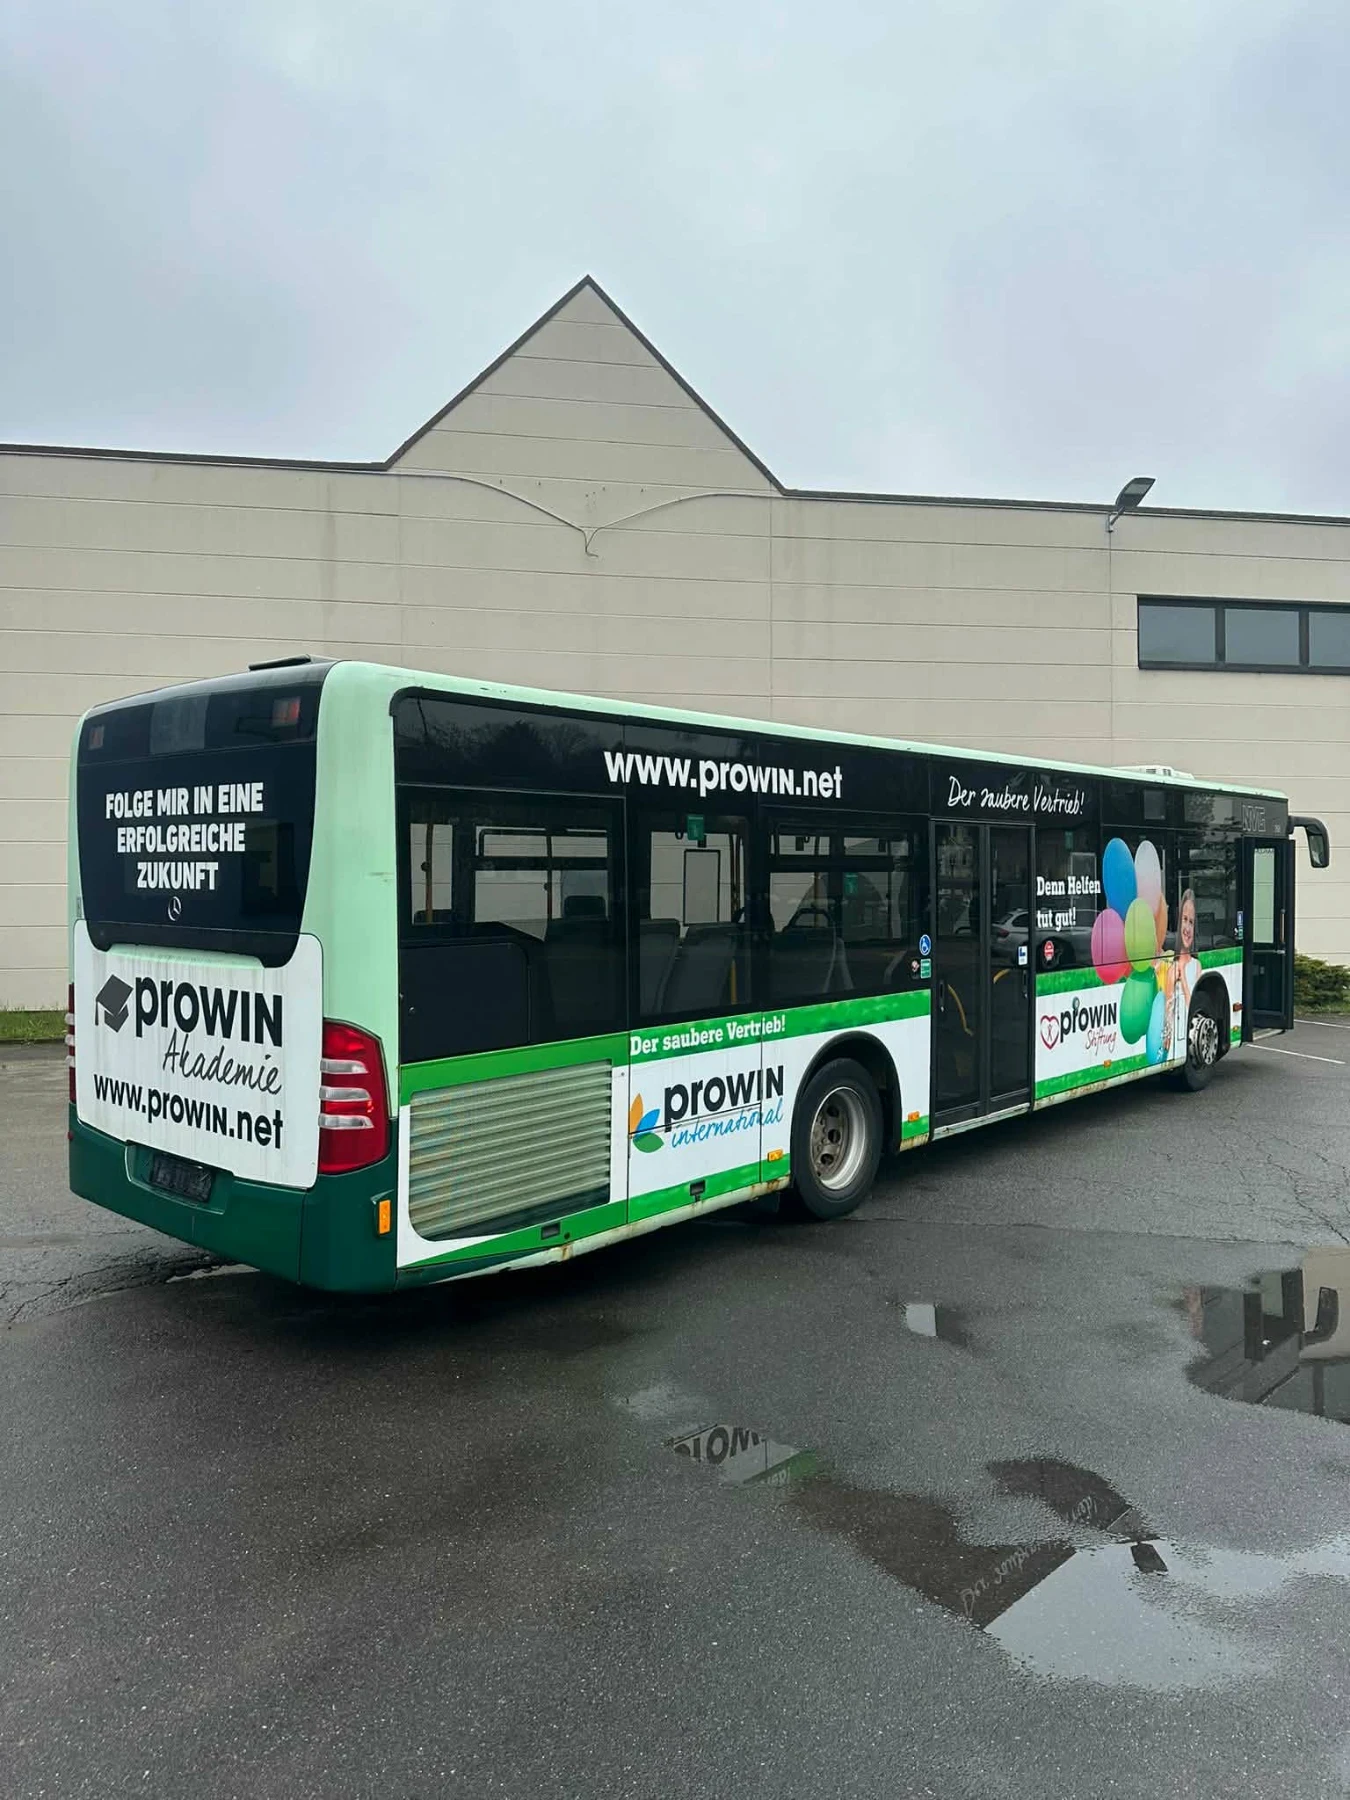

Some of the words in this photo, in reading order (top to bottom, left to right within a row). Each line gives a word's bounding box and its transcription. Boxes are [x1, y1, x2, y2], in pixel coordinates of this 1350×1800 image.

[105, 790, 153, 819] FOLGE
[157, 787, 189, 817] MIR
[194, 785, 213, 815] IN
[218, 782, 264, 814] EINE
[947, 775, 976, 807] Der
[980, 785, 1030, 812] saubere
[1034, 785, 1085, 815] Vertrieb!
[117, 822, 246, 853] ERFOLGREICHE
[137, 862, 219, 890] ZUKUNFT
[1036, 876, 1066, 896] Denn
[1067, 875, 1101, 895] Helfen
[1037, 909, 1053, 928] tut
[1055, 906, 1076, 932] gut!
[630, 1036, 659, 1056] Der
[662, 1028, 723, 1050] saubere
[726, 1015, 786, 1039] Vertrieb!
[1085, 1027, 1117, 1056] Stiftung
[162, 1028, 282, 1095] Akademie
[671, 1097, 783, 1148] international
